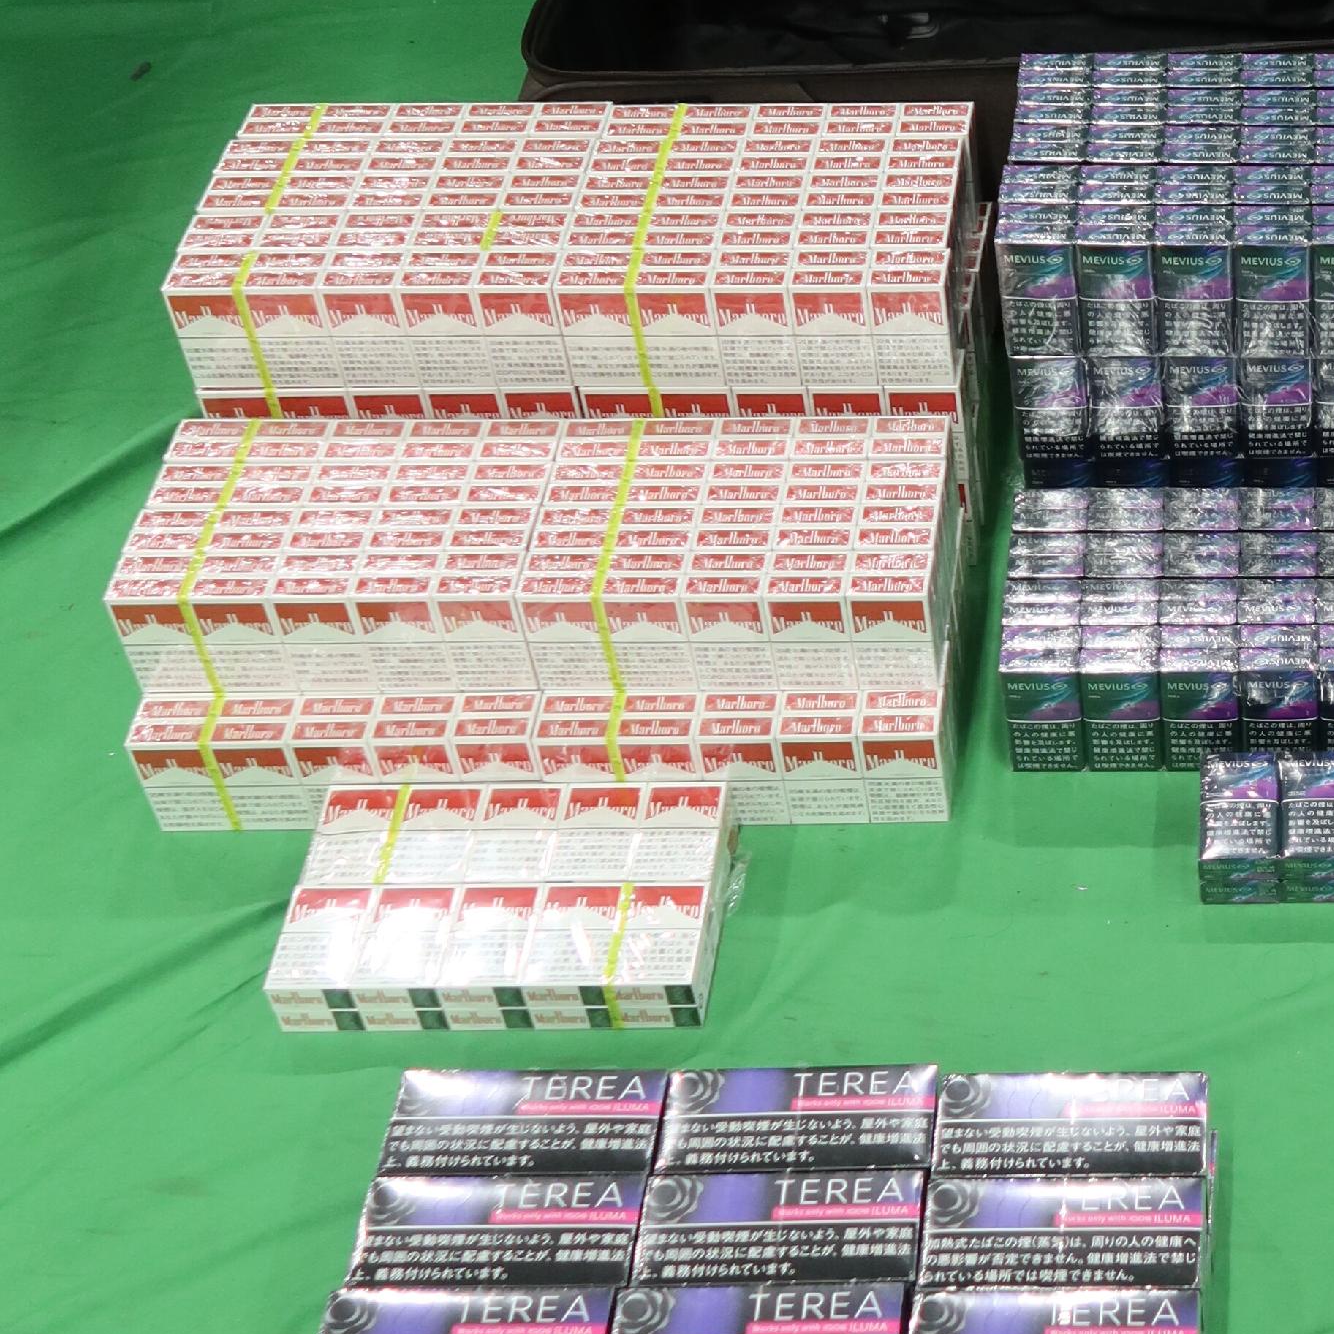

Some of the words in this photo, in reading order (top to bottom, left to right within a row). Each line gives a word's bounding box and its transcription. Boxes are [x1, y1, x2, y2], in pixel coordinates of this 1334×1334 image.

[691, 124, 736, 134] Marlboro
[764, 124, 809, 135] Marlboro
[750, 159, 797, 171] Marlboro
[665, 195, 713, 207] Marlboro
[742, 195, 789, 207] Marlboro
[818, 194, 864, 206] Marlboro
[892, 194, 938, 205] Marlboro
[1004, 255, 1045, 264] MEVIUS
[1082, 256, 1124, 265] MEVIUS
[1161, 256, 1203, 266] MEVIUS
[1241, 256, 1282, 266] MEVIUS
[646, 273, 696, 285] Marlboro
[724, 273, 774, 285] Marlboro
[803, 272, 853, 284] Marlboro
[881, 271, 932, 283] Marlboro
[1008, 682, 1050, 690] MEVIUS
[1088, 682, 1130, 690] MEVIUS
[1167, 682, 1208, 690] MEVIUS
[232, 699, 283, 715] Marlboro
[313, 699, 363, 715] Marlboro
[393, 697, 442, 713] Marlboro
[224, 724, 273, 740] Marlboro
[305, 724, 355, 739] Marlboro
[383, 723, 434, 738] Marlboro
[523, 1075, 646, 1100] TEREA
[794, 1071, 920, 1097] TEREA
[498, 1181, 624, 1208] TEREA
[774, 1177, 904, 1204] TEREA
[1081, 1185, 1185, 1210] EREA
[460, 1296, 590, 1324] TEREA
[749, 1292, 883, 1320] TEREA
[1051, 1298, 1179, 1326] TEREA
